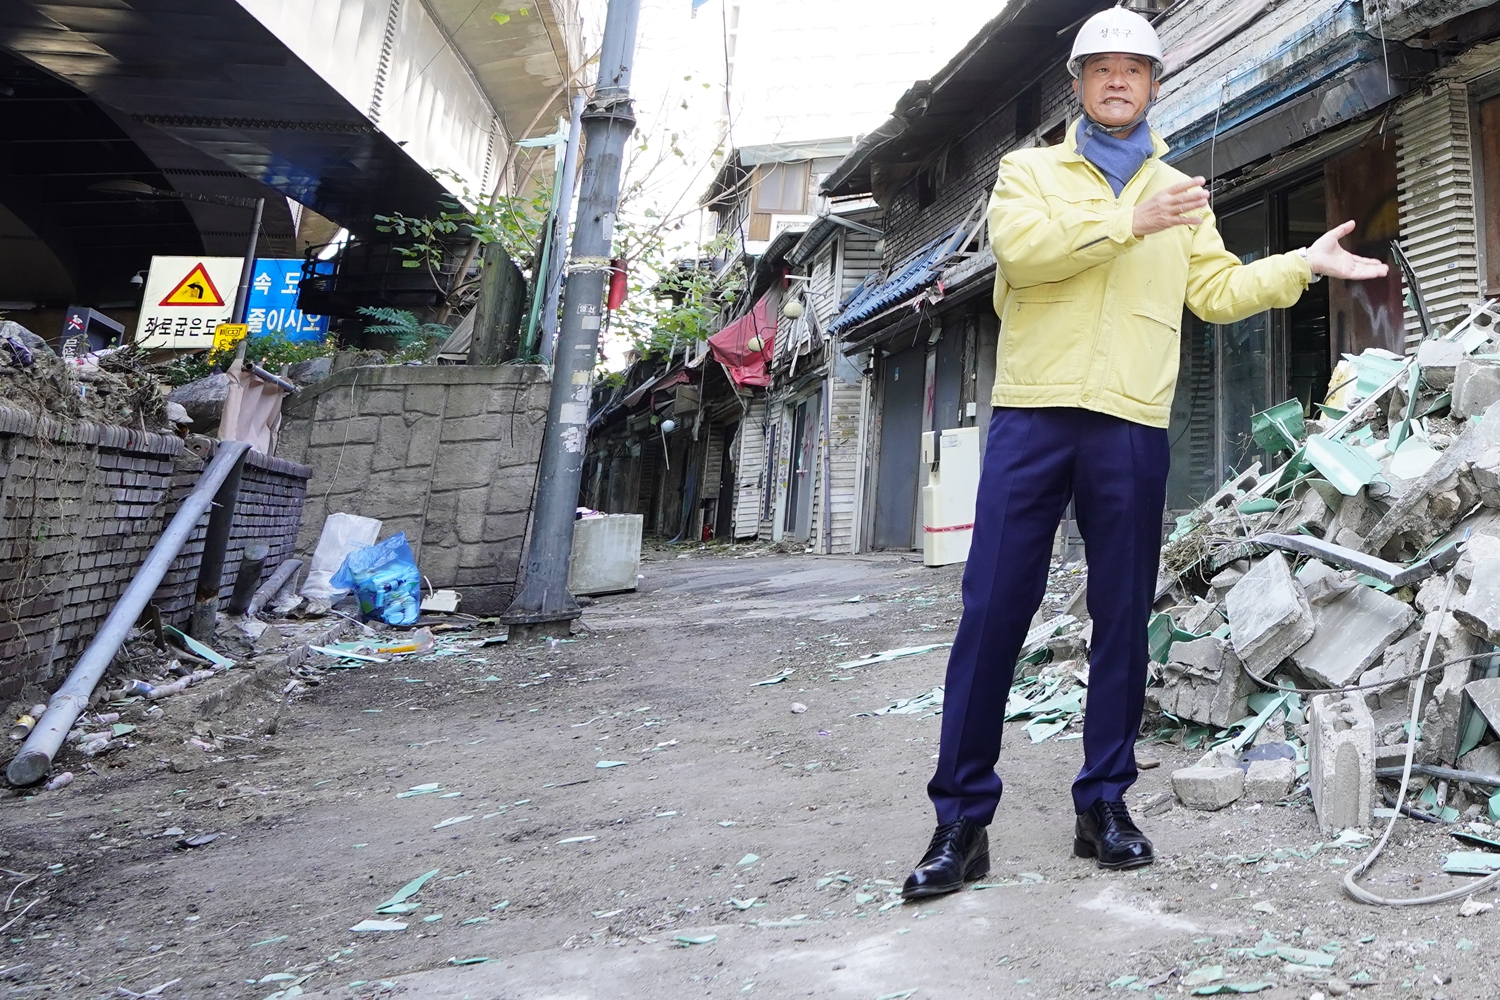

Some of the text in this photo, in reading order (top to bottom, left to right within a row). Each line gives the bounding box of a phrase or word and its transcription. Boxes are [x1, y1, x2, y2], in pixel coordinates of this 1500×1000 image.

[1099, 27, 1133, 39] 성북구
[253, 271, 312, 296] 속도
[247, 307, 321, 333] 줄이시오
